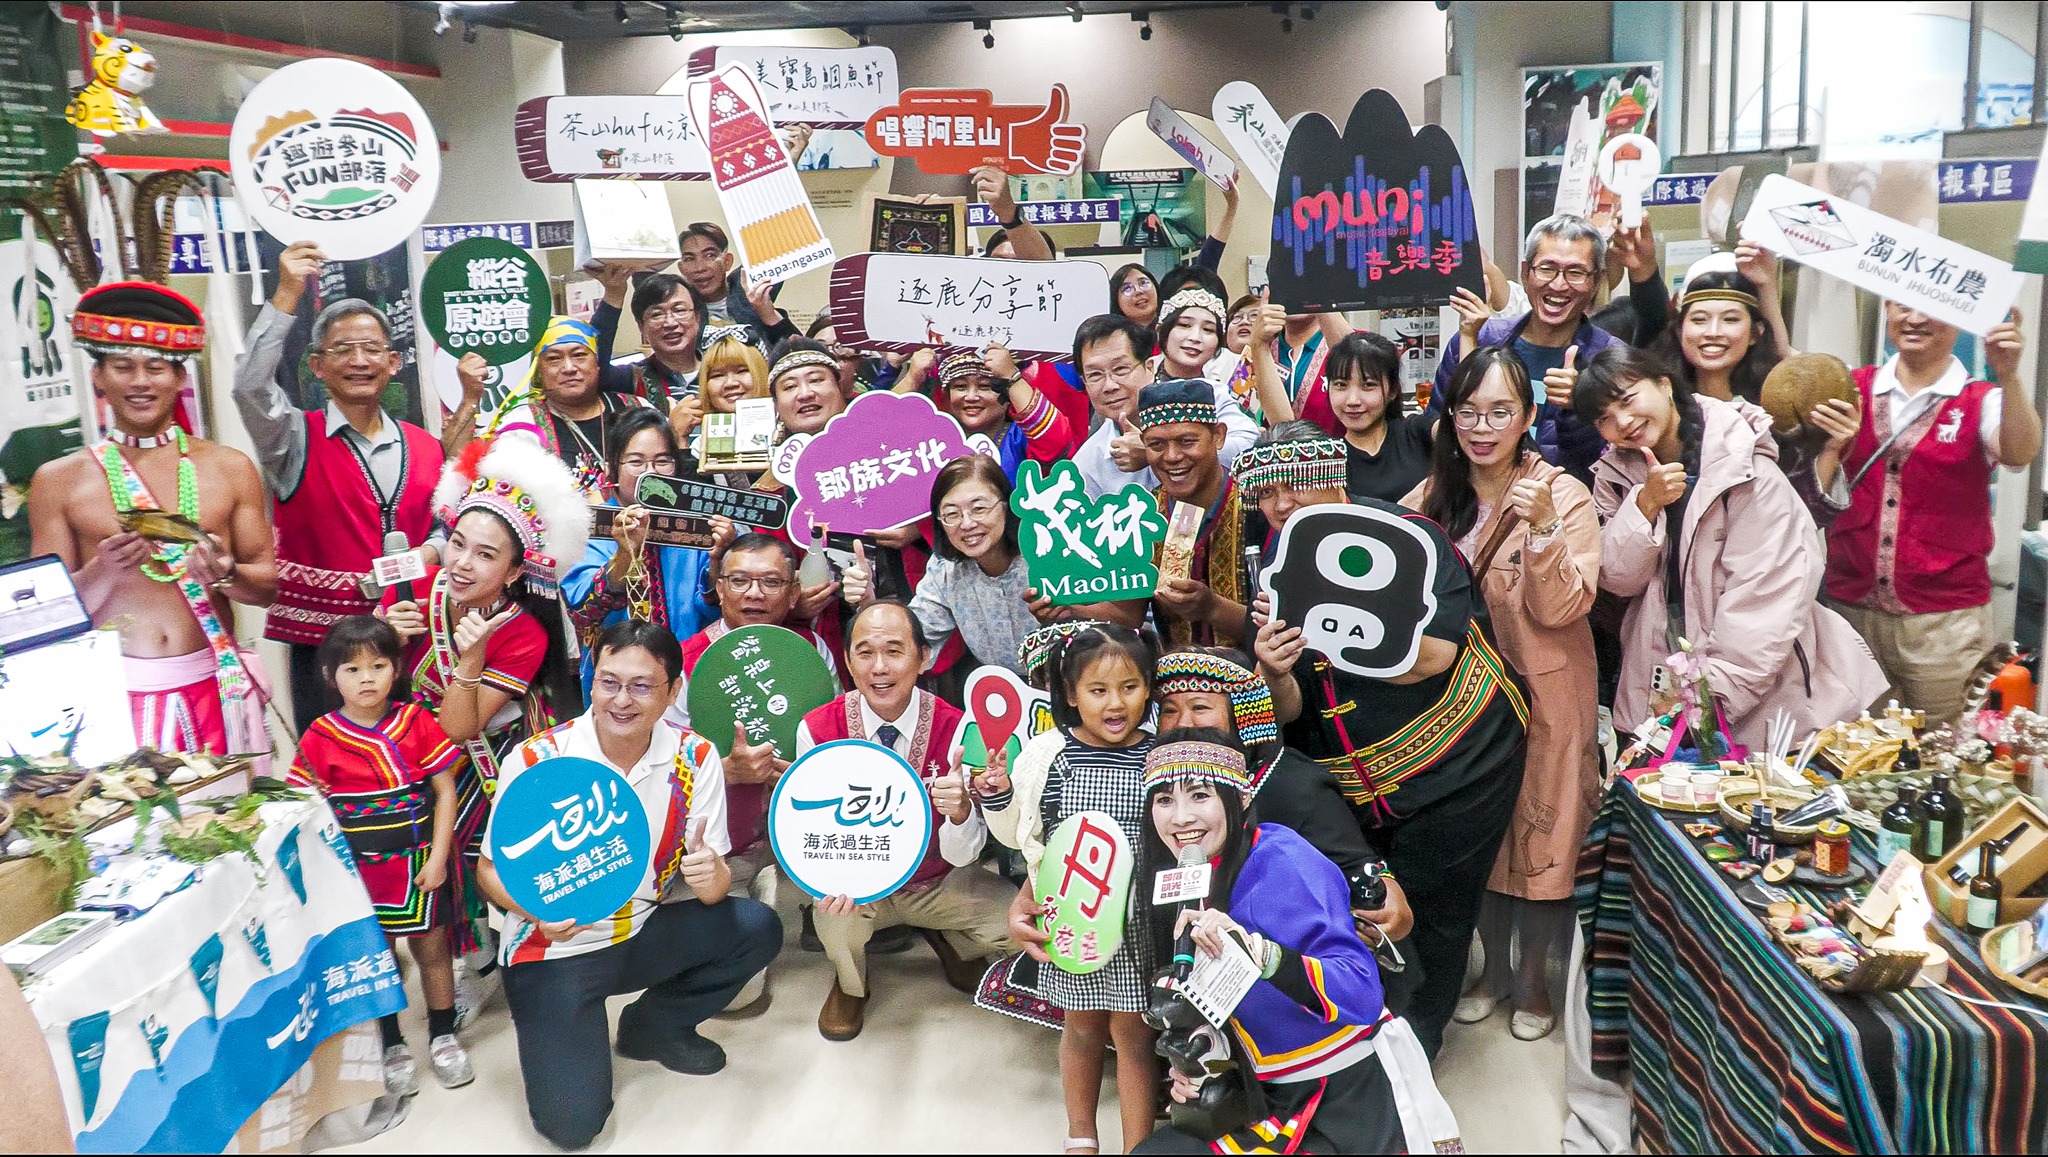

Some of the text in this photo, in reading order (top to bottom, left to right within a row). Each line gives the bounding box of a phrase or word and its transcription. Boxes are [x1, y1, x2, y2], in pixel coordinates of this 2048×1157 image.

[876, 114, 1001, 147] 唱響阿里山
[1940, 163, 2013, 198] 報專區
[969, 202, 1110, 223] 國外體報導專區
[1293, 187, 1424, 235] muni
[168, 236, 213, 269] 專區
[1366, 240, 1462, 281] 音樂季
[1864, 231, 1987, 300] 濁水布農
[466, 257, 529, 289] 縱谷
[1858, 259, 1901, 283] BUNUN
[898, 275, 1063, 322] 逐鹿分享節
[445, 299, 531, 333] 原遊會
[1020, 469, 1159, 568] 茂林
[1040, 567, 1148, 597] Maolin
[803, 832, 891, 851] 海派過生活
[803, 851, 890, 861] TRAVEL IN SEA STYLE
[533, 834, 629, 895] 海派過生活
[542, 854, 633, 905] TRAVEL IN SEA STYLE
